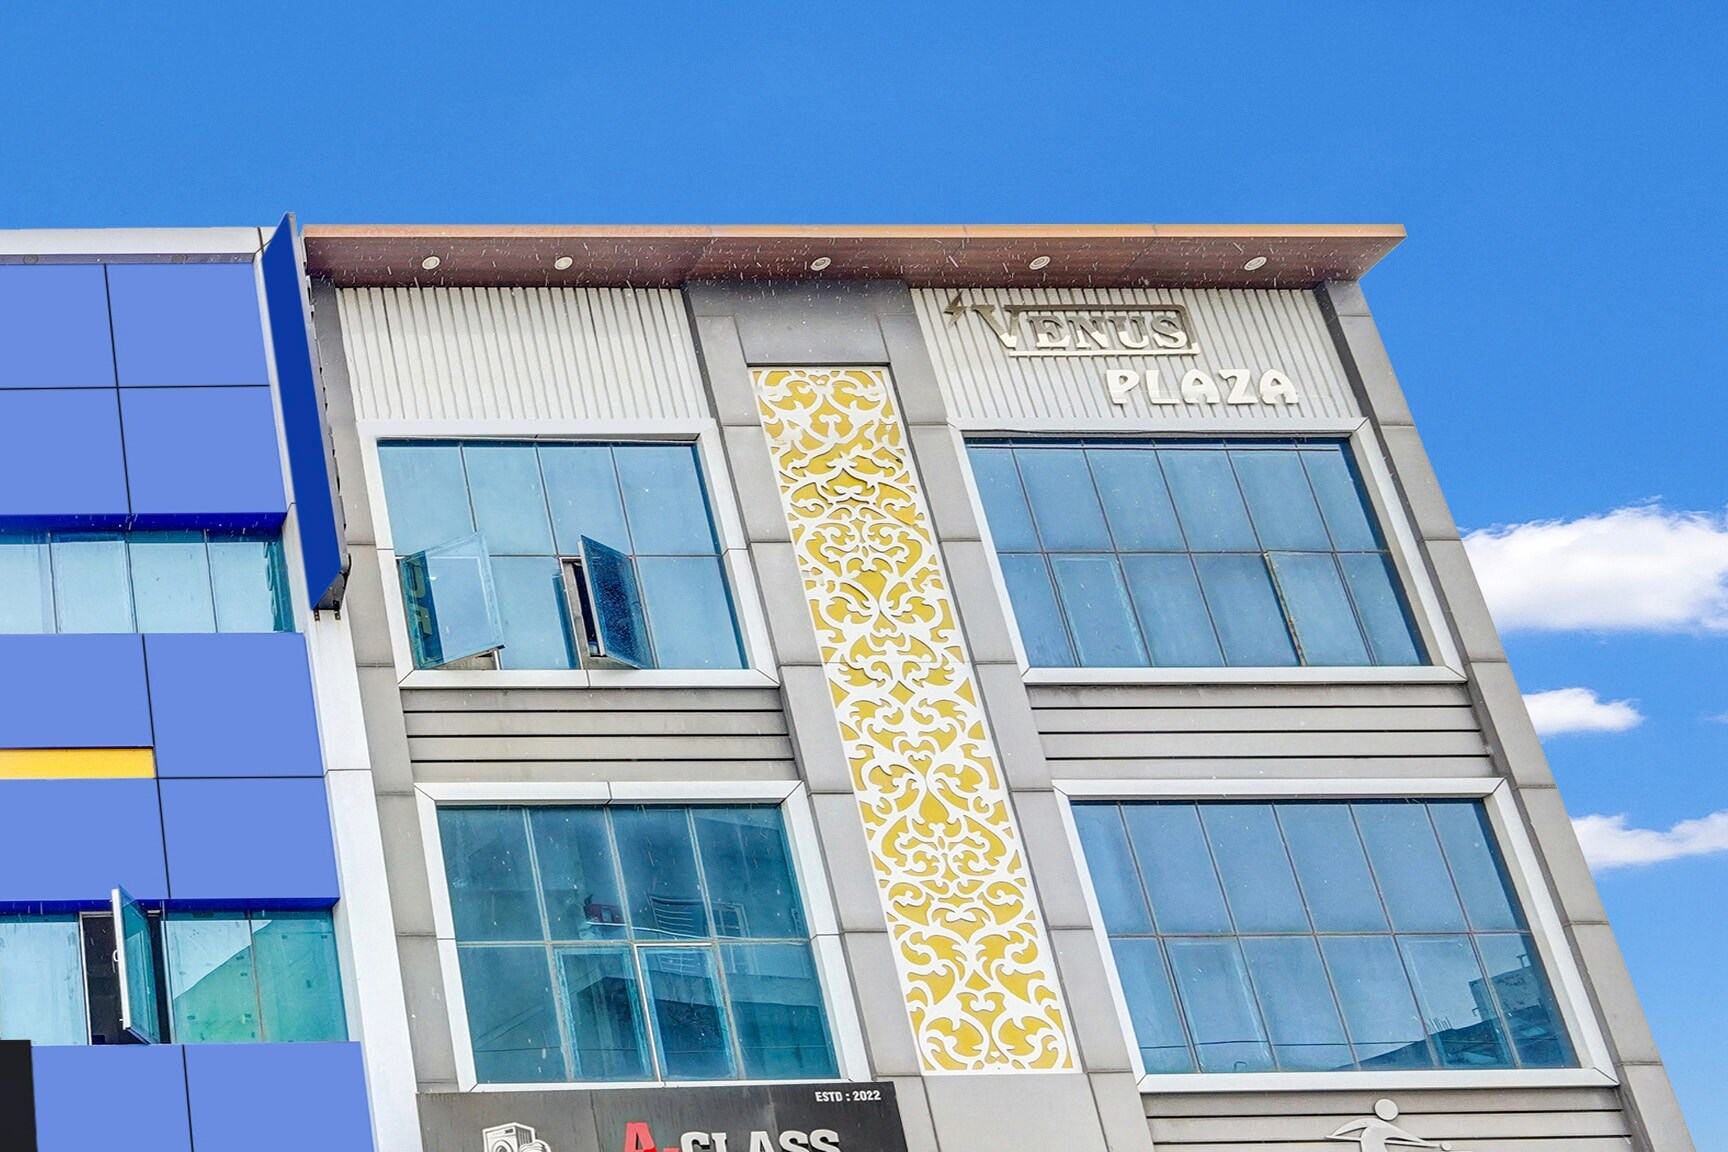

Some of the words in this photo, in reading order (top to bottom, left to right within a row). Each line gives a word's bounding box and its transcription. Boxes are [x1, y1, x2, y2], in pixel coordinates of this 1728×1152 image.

[973, 304, 1188, 349] VENUS
[1105, 368, 1299, 404] PLAZA
[815, 1091, 843, 1102] ESTD
[852, 1090, 881, 1101] 2022
